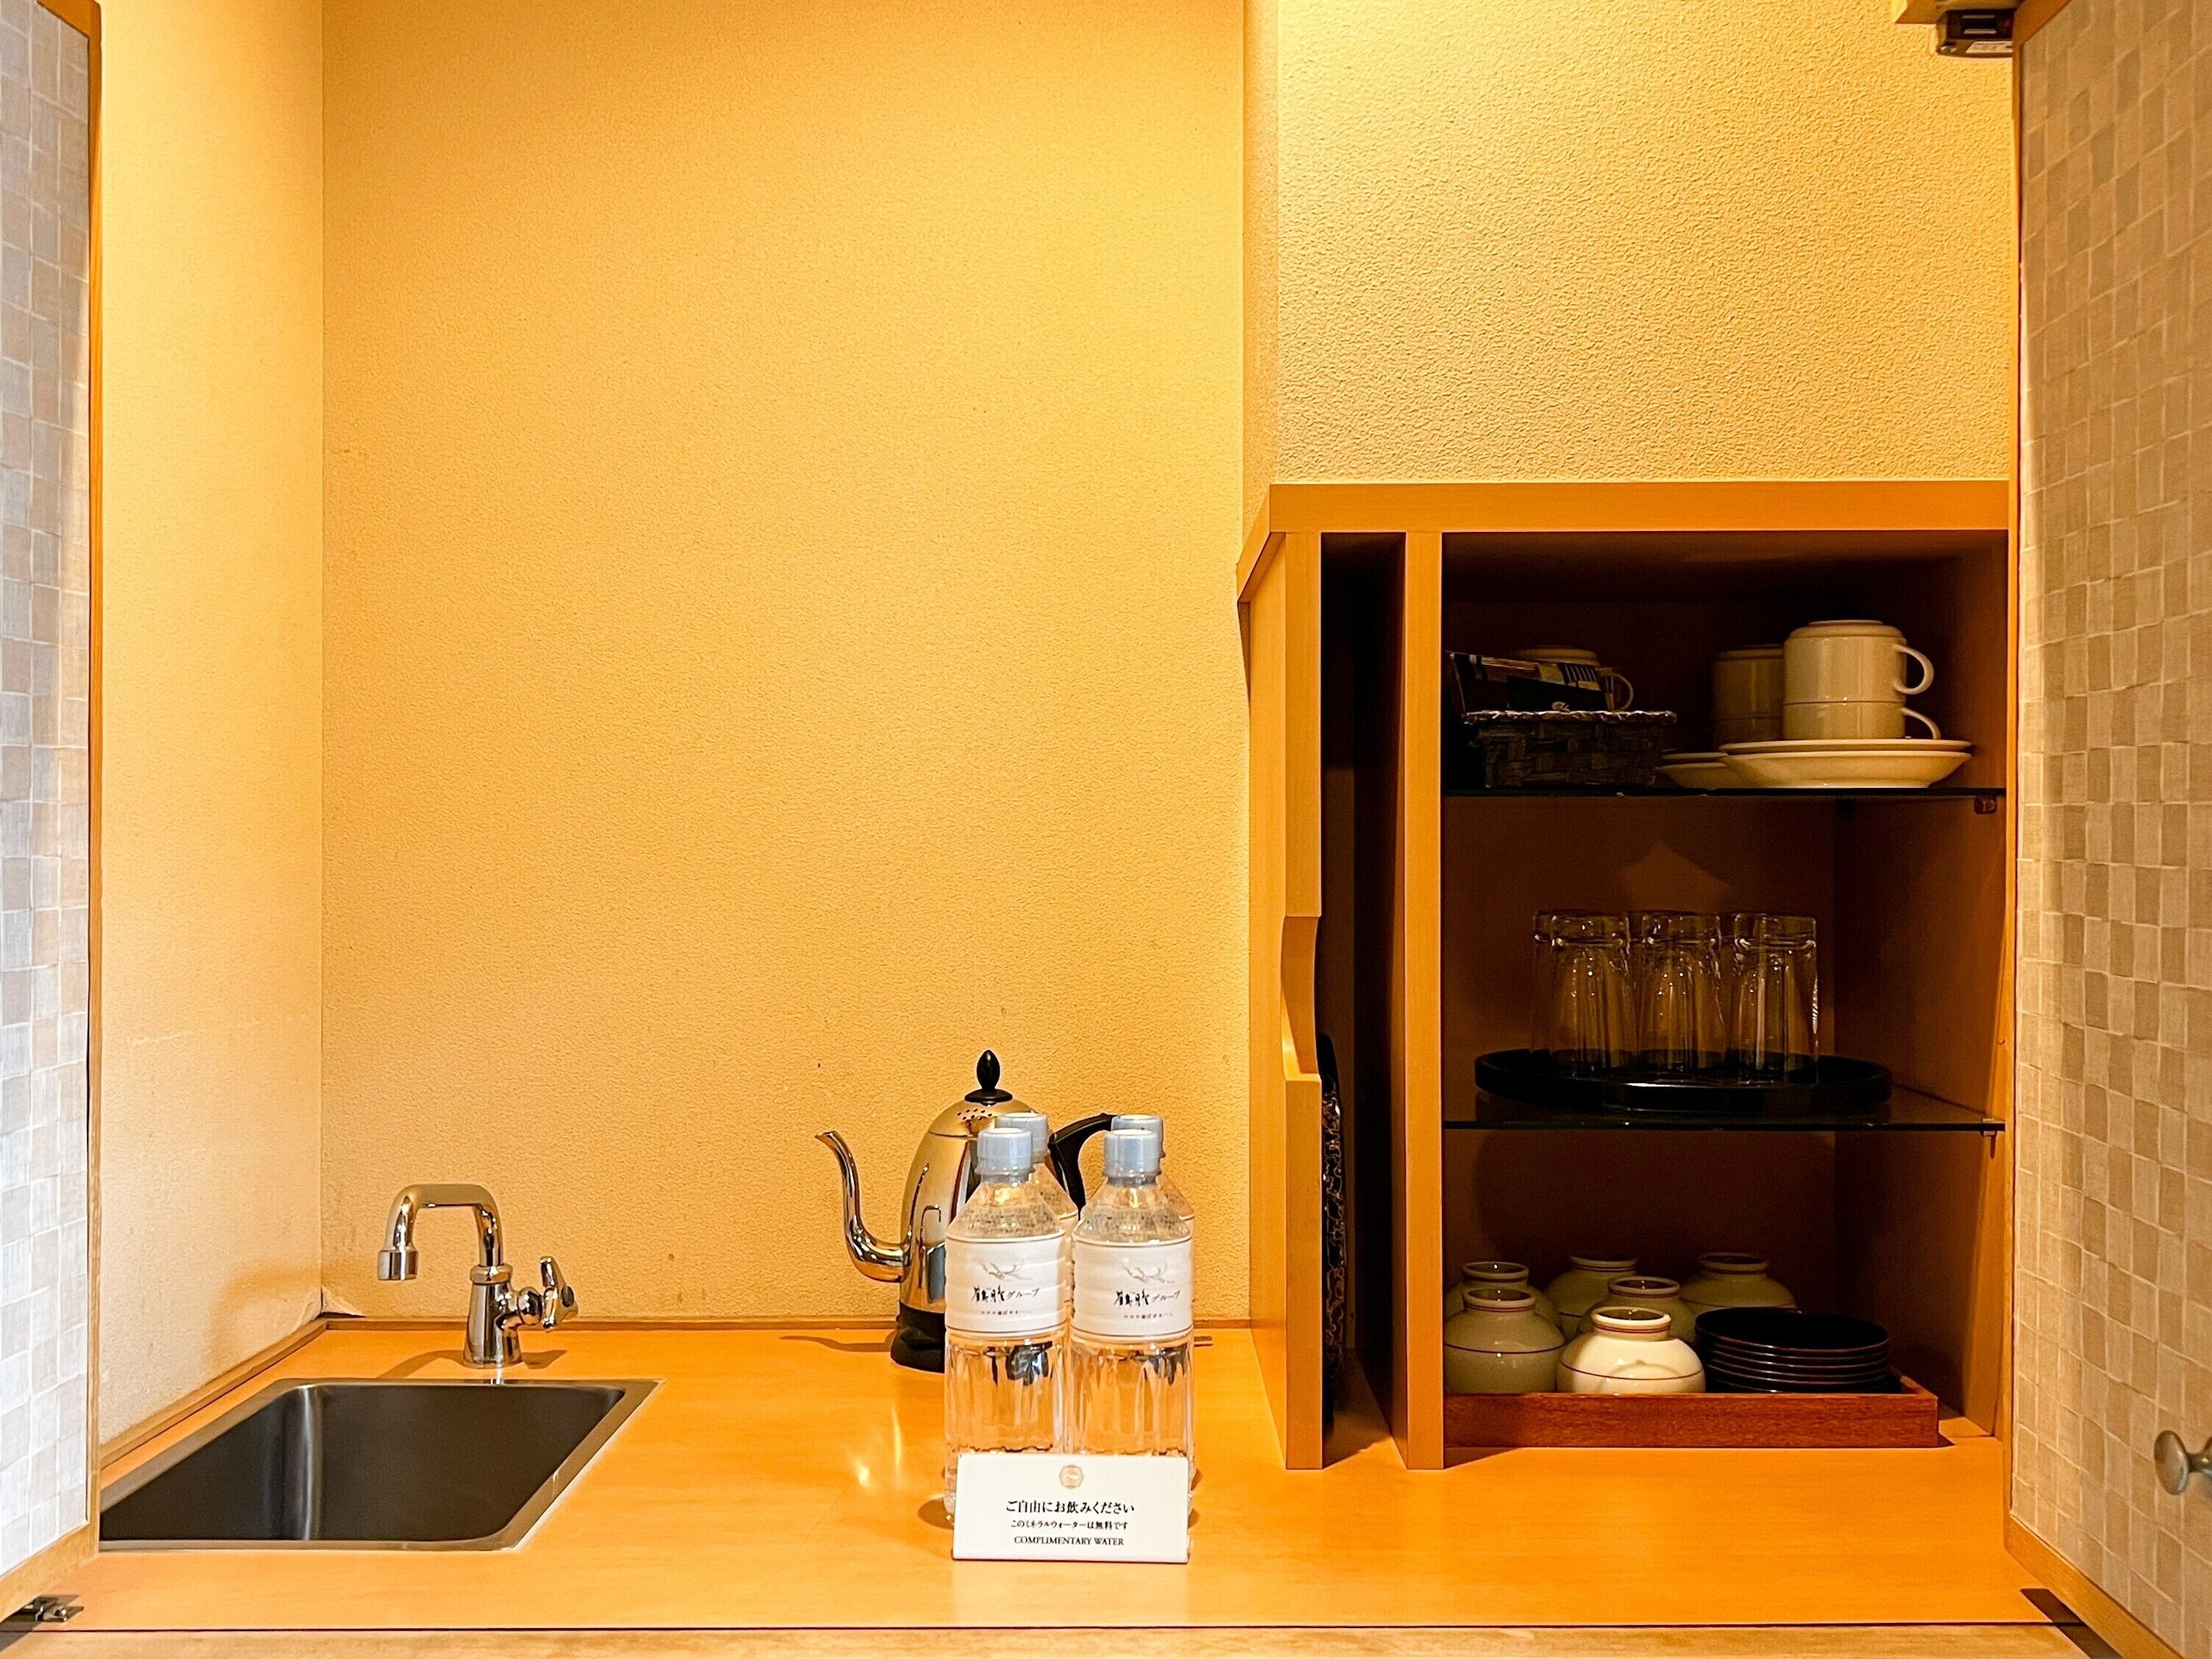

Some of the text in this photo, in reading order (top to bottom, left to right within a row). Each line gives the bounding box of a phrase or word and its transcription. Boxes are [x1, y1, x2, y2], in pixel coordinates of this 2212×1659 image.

[1006, 1500, 1135, 1514] ご自由にお飲みください
[1010, 1520, 1128, 1530] このミネラルウォーターは無料です
[1014, 1536, 1124, 1546] COMPLIMENTARY WATER
